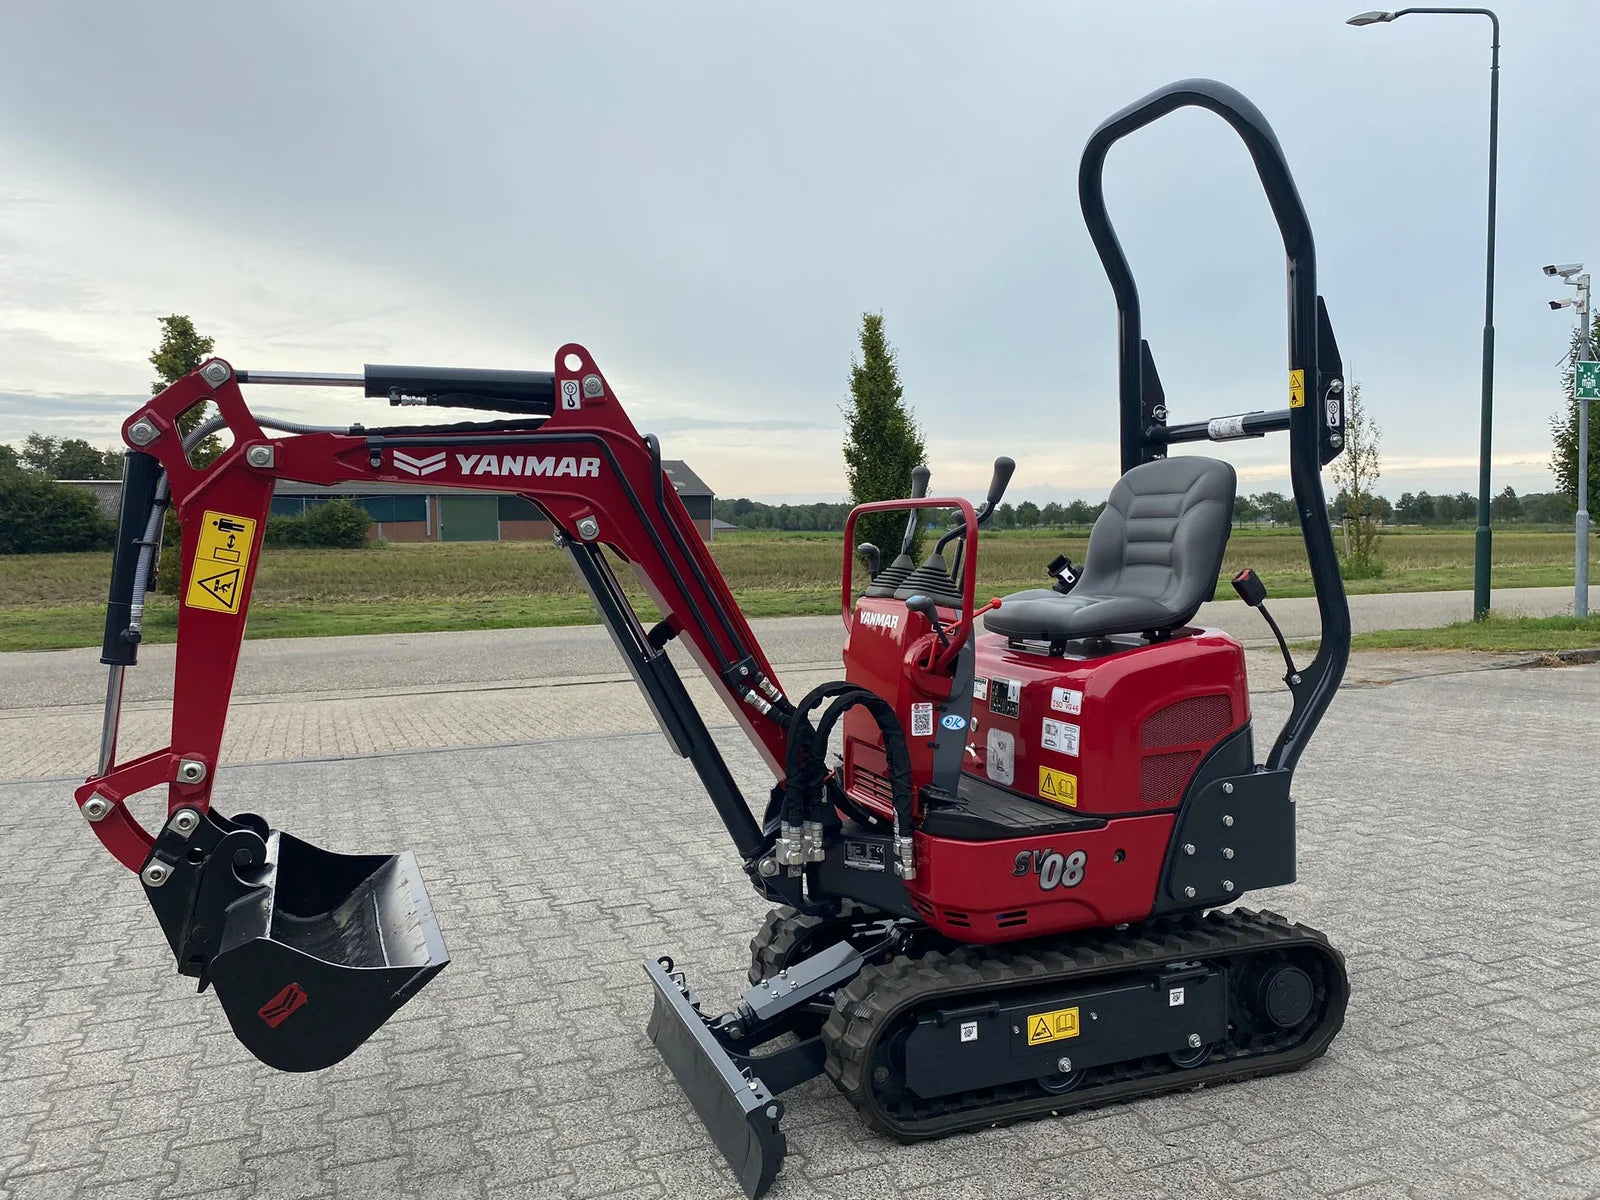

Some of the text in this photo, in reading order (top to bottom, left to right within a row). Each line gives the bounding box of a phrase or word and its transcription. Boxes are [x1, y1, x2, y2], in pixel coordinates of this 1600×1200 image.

[455, 454, 601, 478] YANMAR
[860, 611, 899, 628] YANMAR
[1052, 700, 1063, 709] ISO
[944, 716, 962, 728] OK
